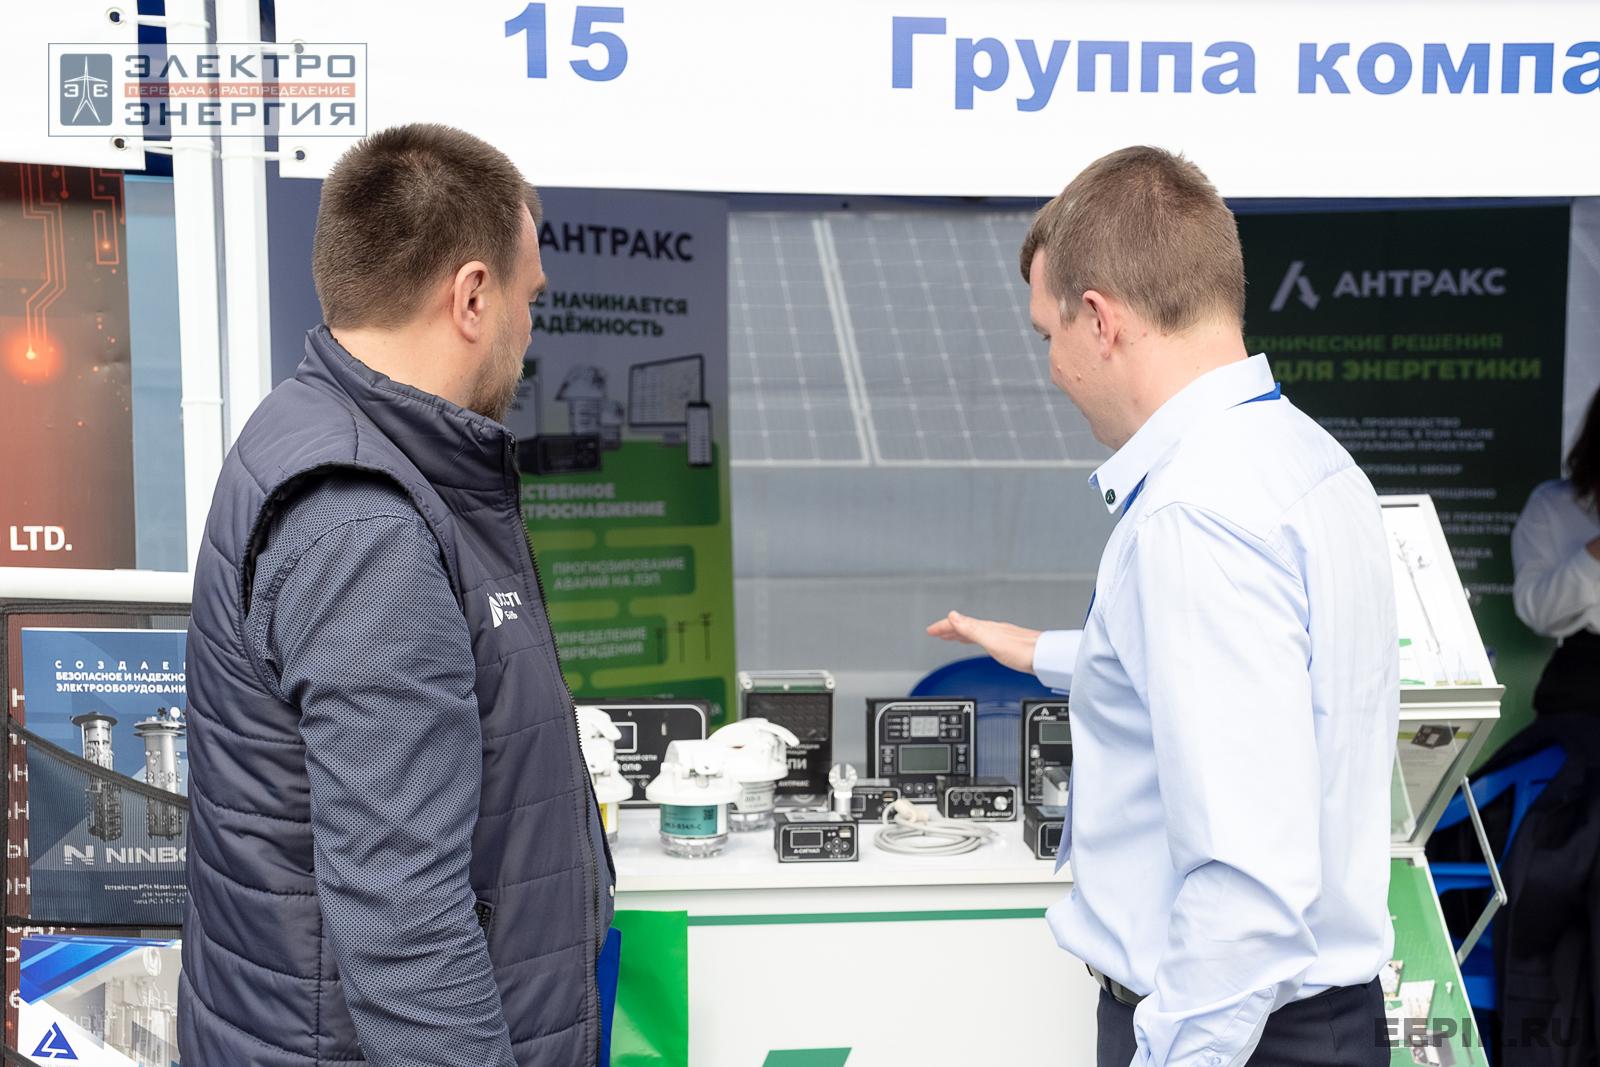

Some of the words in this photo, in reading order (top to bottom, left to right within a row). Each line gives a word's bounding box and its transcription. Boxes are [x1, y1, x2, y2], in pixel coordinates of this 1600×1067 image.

[503, 1, 629, 82] 15
[891, 15, 1257, 112] Группа
[1298, 41, 1600, 95] компа
[539, 222, 694, 262] АНТРАКС
[1333, 267, 1506, 298] АНТРАКС
[552, 292, 689, 316] НАЧИНАЕТСЯ
[532, 312, 664, 337] АДЁЖНОСТЬ
[1391, 332, 1504, 351] РЕШЕНИЯ
[1274, 359, 1335, 383] ДЛЯ
[1342, 357, 1542, 381] ЭНЕРГЕТИКИ
[521, 483, 616, 499] СТВЕННОЕ
[9, 525, 73, 551] LTD.
[54, 660, 186, 671] СОЗДАЕ
[55, 672, 122, 681] БЕЗОПАСНОЕ
[124, 673, 132, 681] И
